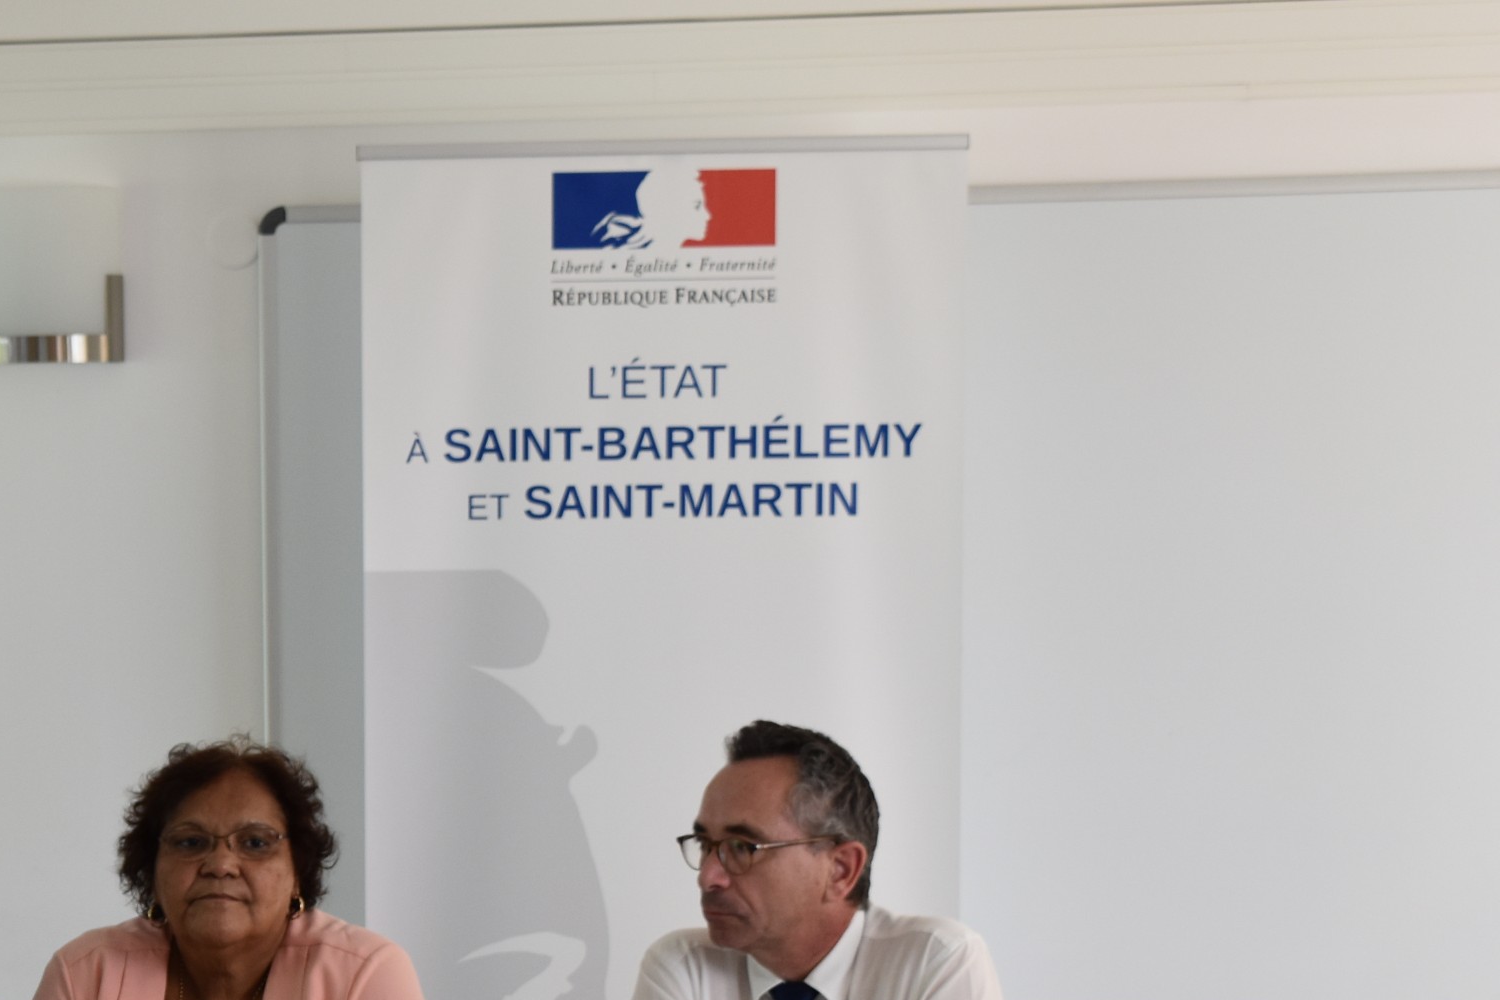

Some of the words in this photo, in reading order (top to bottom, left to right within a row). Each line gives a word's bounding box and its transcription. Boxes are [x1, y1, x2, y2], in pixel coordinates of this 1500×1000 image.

[550, 259, 603, 275] Liberté
[624, 256, 678, 277] Égalité
[699, 256, 776, 272] Fraternité
[552, 288, 668, 308] RÉPUBLIQUE
[675, 286, 776, 307] FRANÇAISE
[405, 432, 429, 464] À
[444, 415, 923, 464] SAINT-BARTHÉLEMY
[467, 493, 510, 521] ET
[524, 482, 859, 520] SAINT-MARTIN
